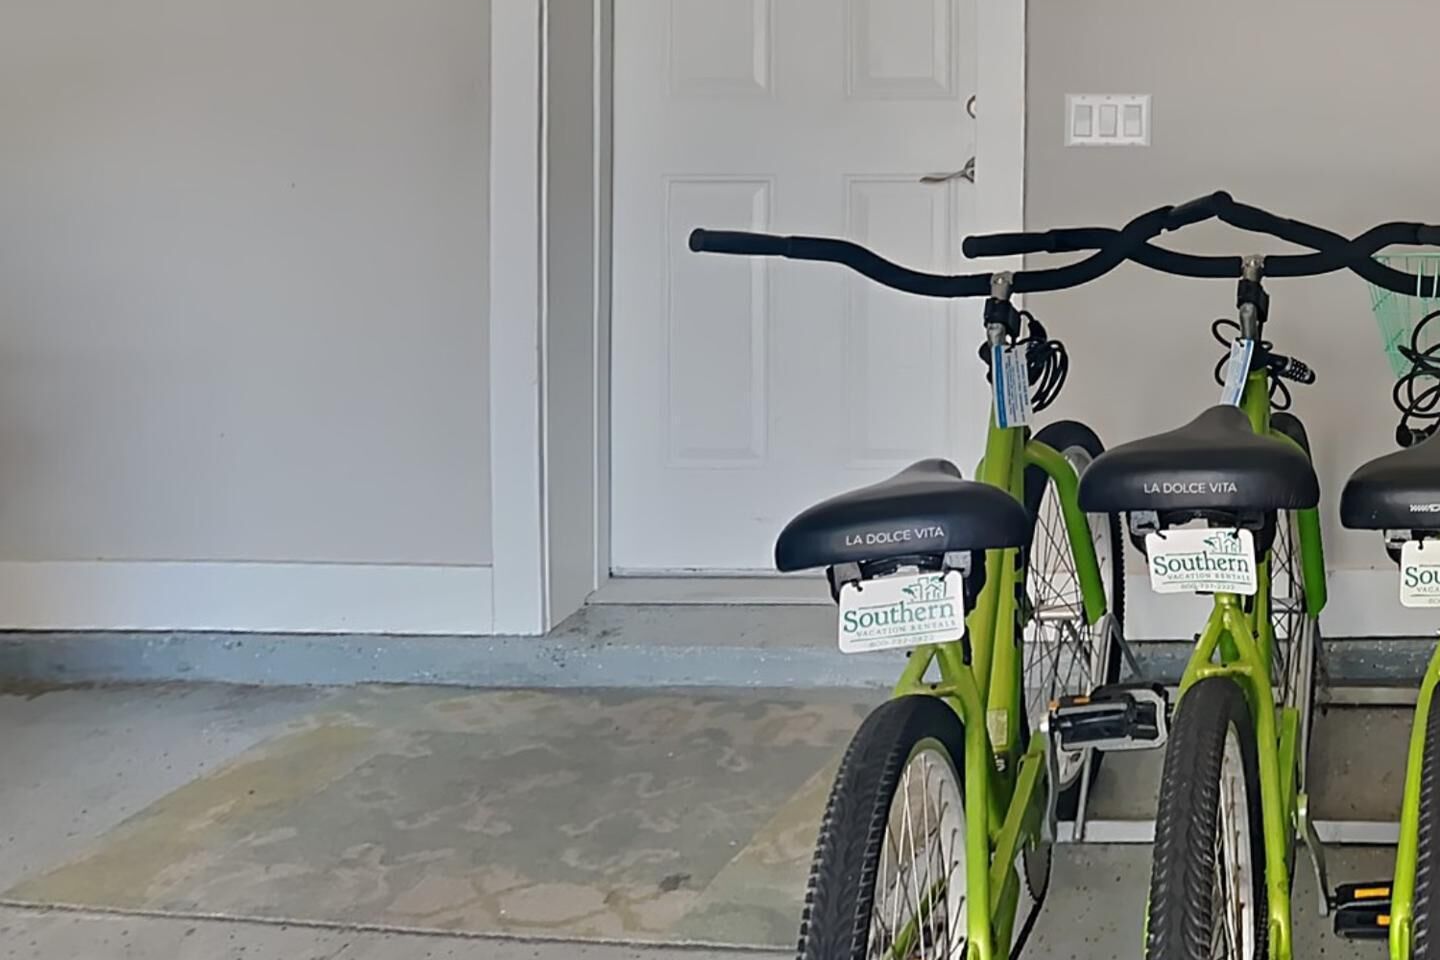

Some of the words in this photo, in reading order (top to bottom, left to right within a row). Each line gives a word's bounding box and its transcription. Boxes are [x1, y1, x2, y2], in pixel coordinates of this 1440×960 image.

[1143, 482, 1160, 494] LA
[1163, 482, 1206, 494] DOLCE
[1209, 482, 1238, 493] VITA
[845, 534, 863, 546] LA
[866, 529, 912, 546] DOLCE
[914, 525, 945, 539] VITA
[1153, 550, 1249, 576] Southern
[843, 600, 955, 634] Southern
[856, 623, 907, 638] VACATION
